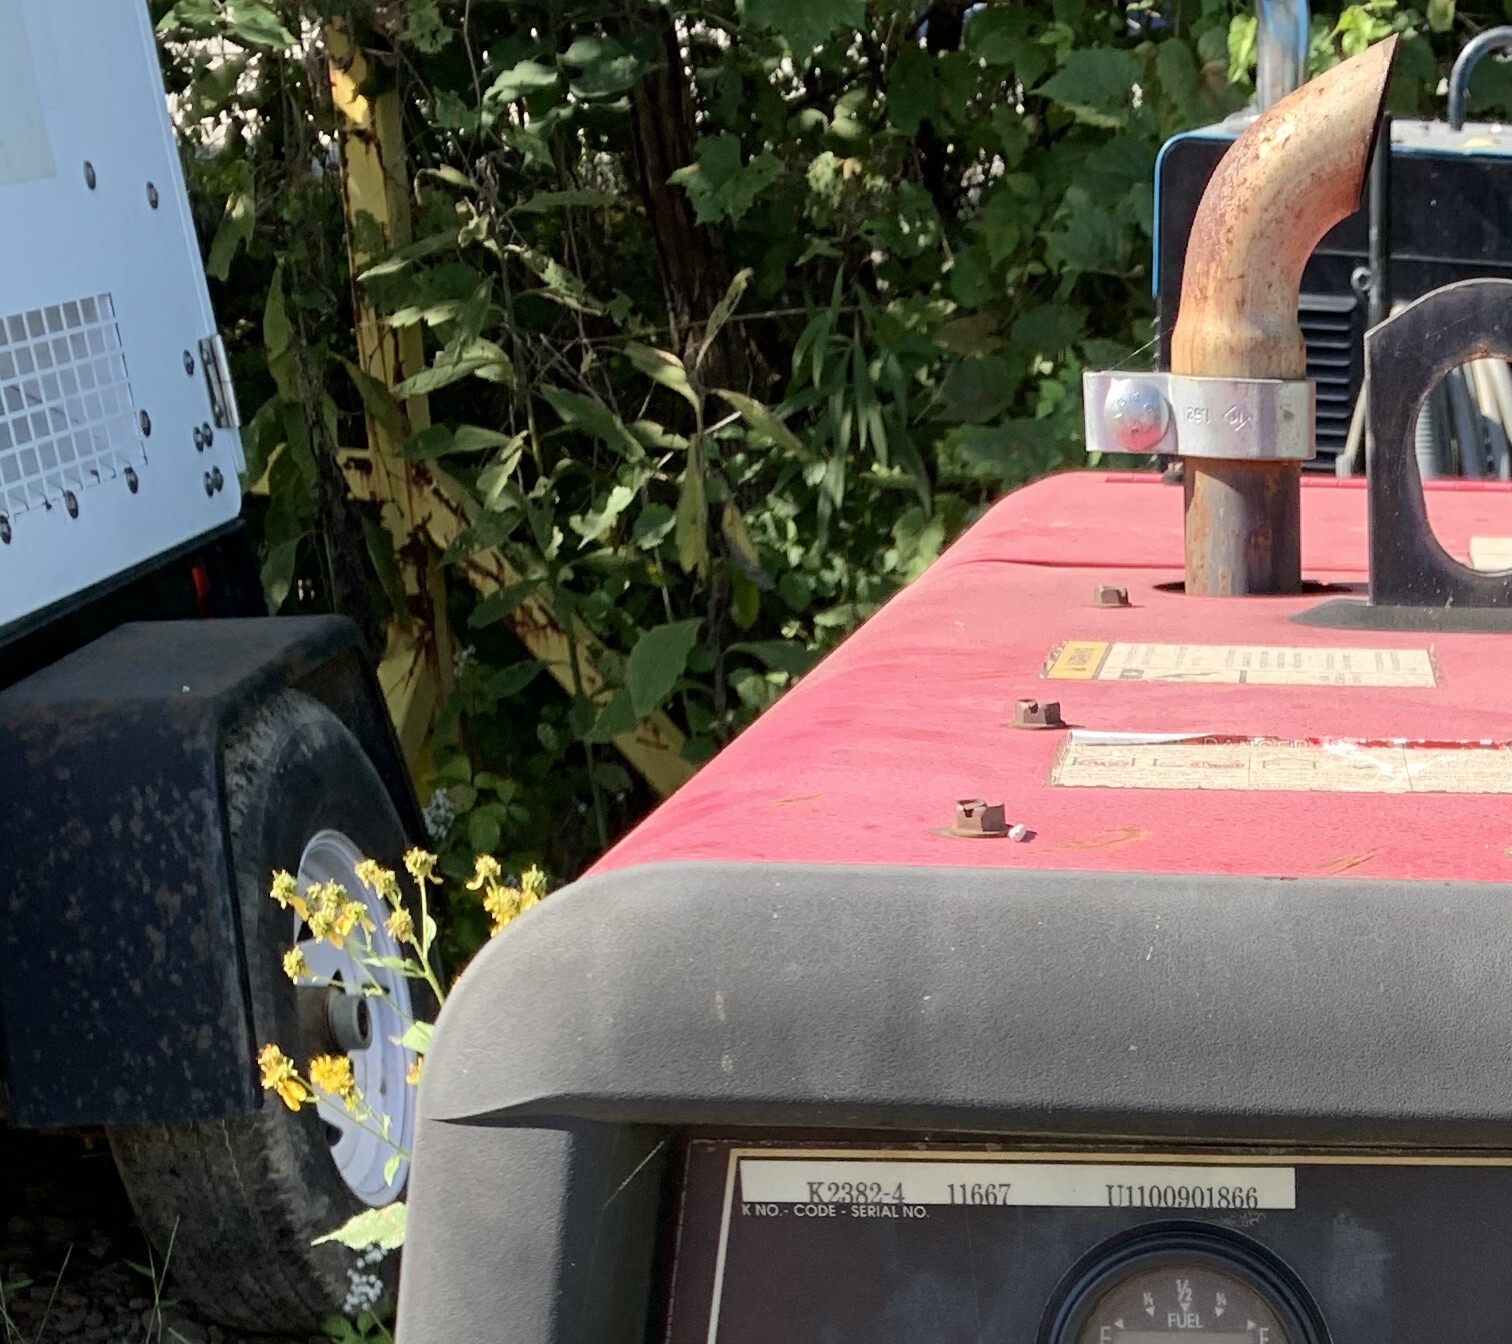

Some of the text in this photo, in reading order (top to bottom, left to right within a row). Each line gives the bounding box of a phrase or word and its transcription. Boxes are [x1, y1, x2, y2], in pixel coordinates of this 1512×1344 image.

[808, 1182, 1259, 1209] K2382-4 11667 U1100901866
[742, 1204, 751, 1216] K
[793, 1205, 837, 1217] CODE
[851, 1206, 899, 1218] SERIAL
[903, 1206, 930, 1218] NO.
[1168, 1313, 1203, 1328] FUEL
